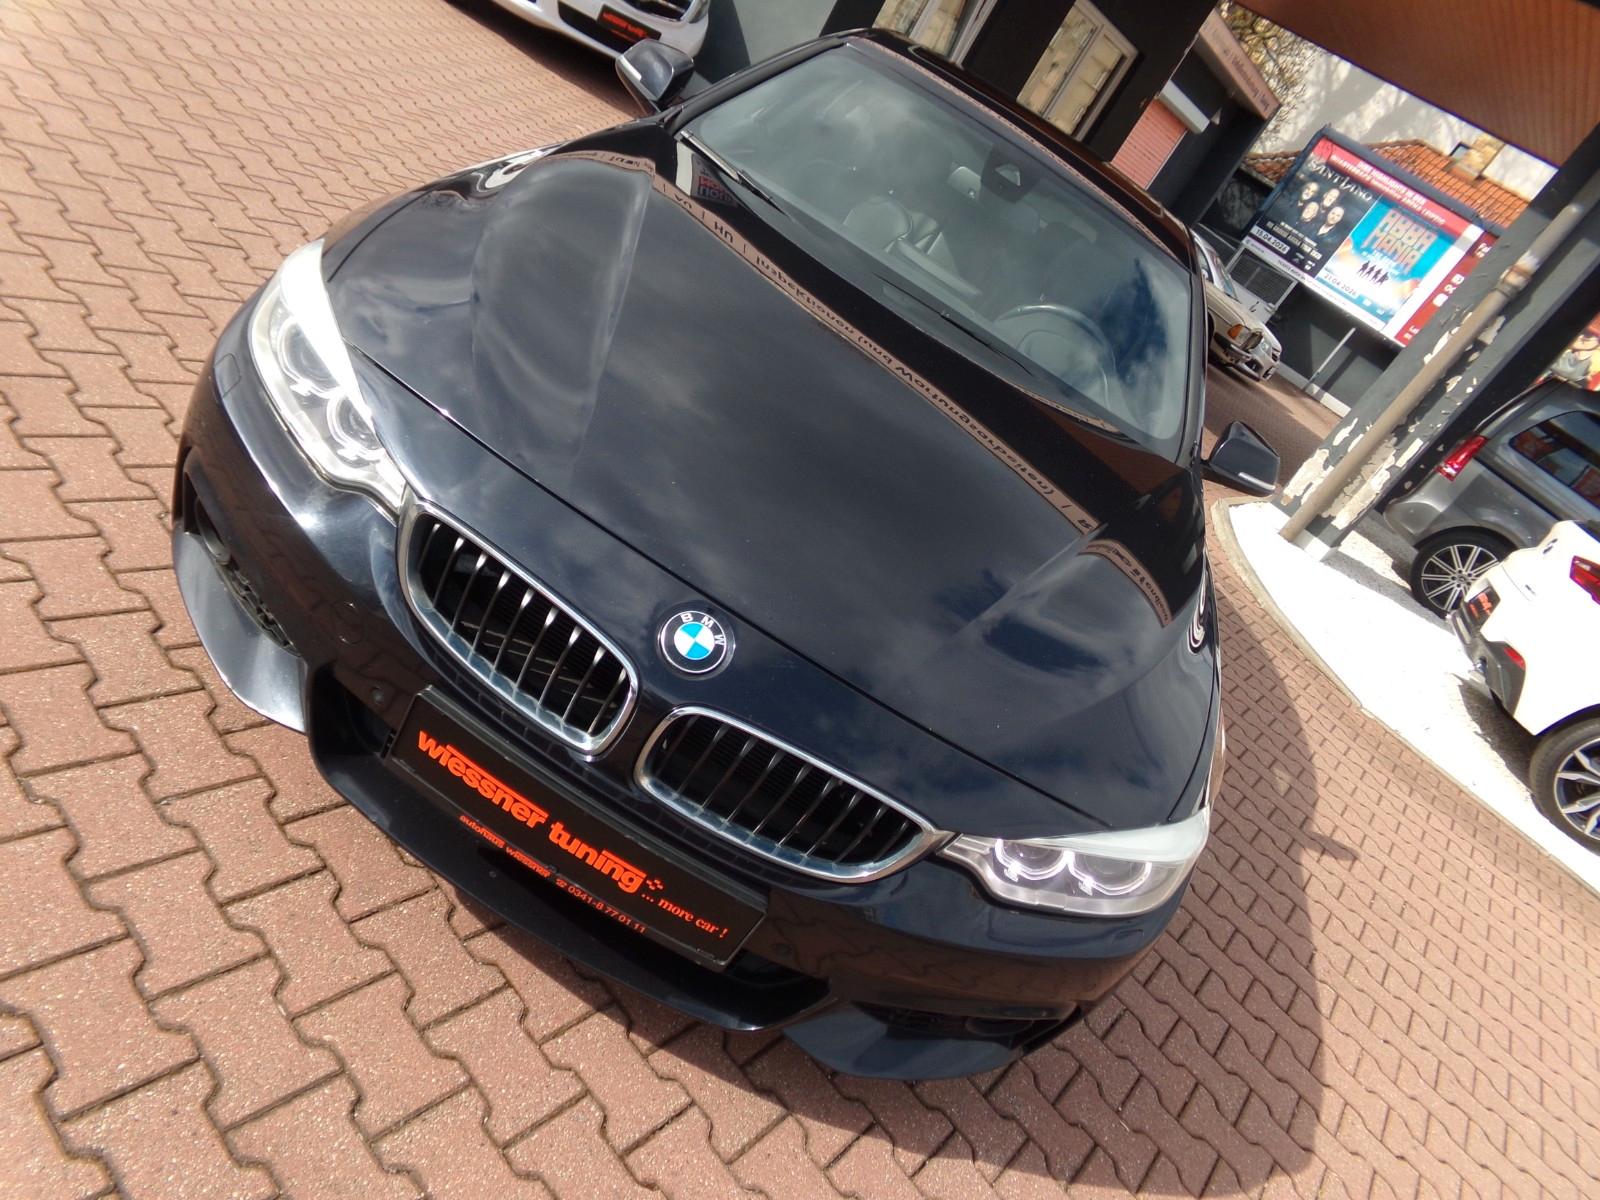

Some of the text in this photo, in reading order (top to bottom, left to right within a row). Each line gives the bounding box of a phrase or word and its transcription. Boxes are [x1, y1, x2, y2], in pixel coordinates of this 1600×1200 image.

[680, 612, 726, 647] BMW
[418, 731, 647, 894] wiessner tuning
[658, 898, 694, 922] more
[695, 918, 719, 935] car
